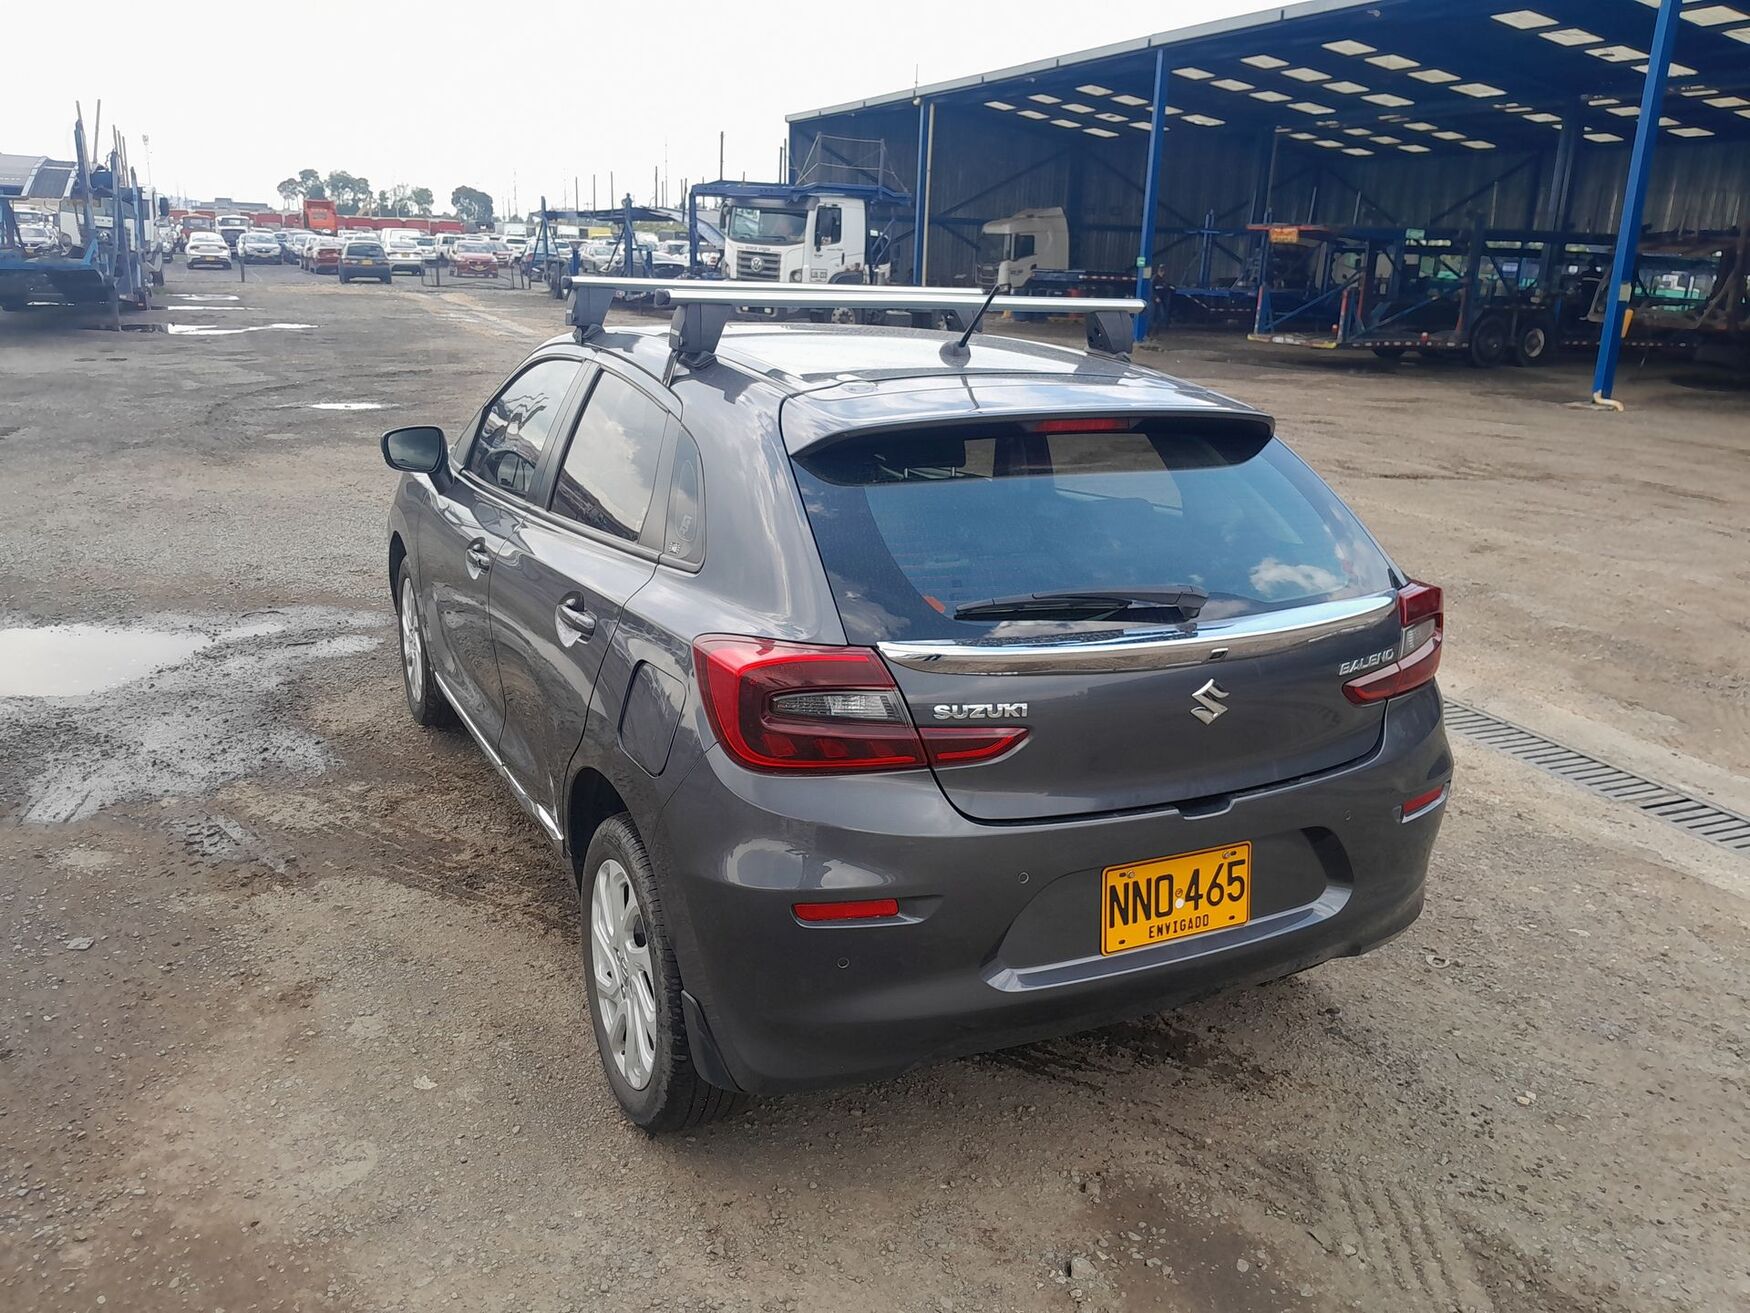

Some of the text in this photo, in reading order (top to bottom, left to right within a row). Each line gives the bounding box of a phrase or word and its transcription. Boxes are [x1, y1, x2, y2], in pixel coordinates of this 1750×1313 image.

[1339, 648, 1394, 676] BALENO
[933, 702, 1028, 720] SUZUKI
[1109, 859, 1246, 928] NNO 465
[1148, 914, 1209, 938] ENVIGADO
